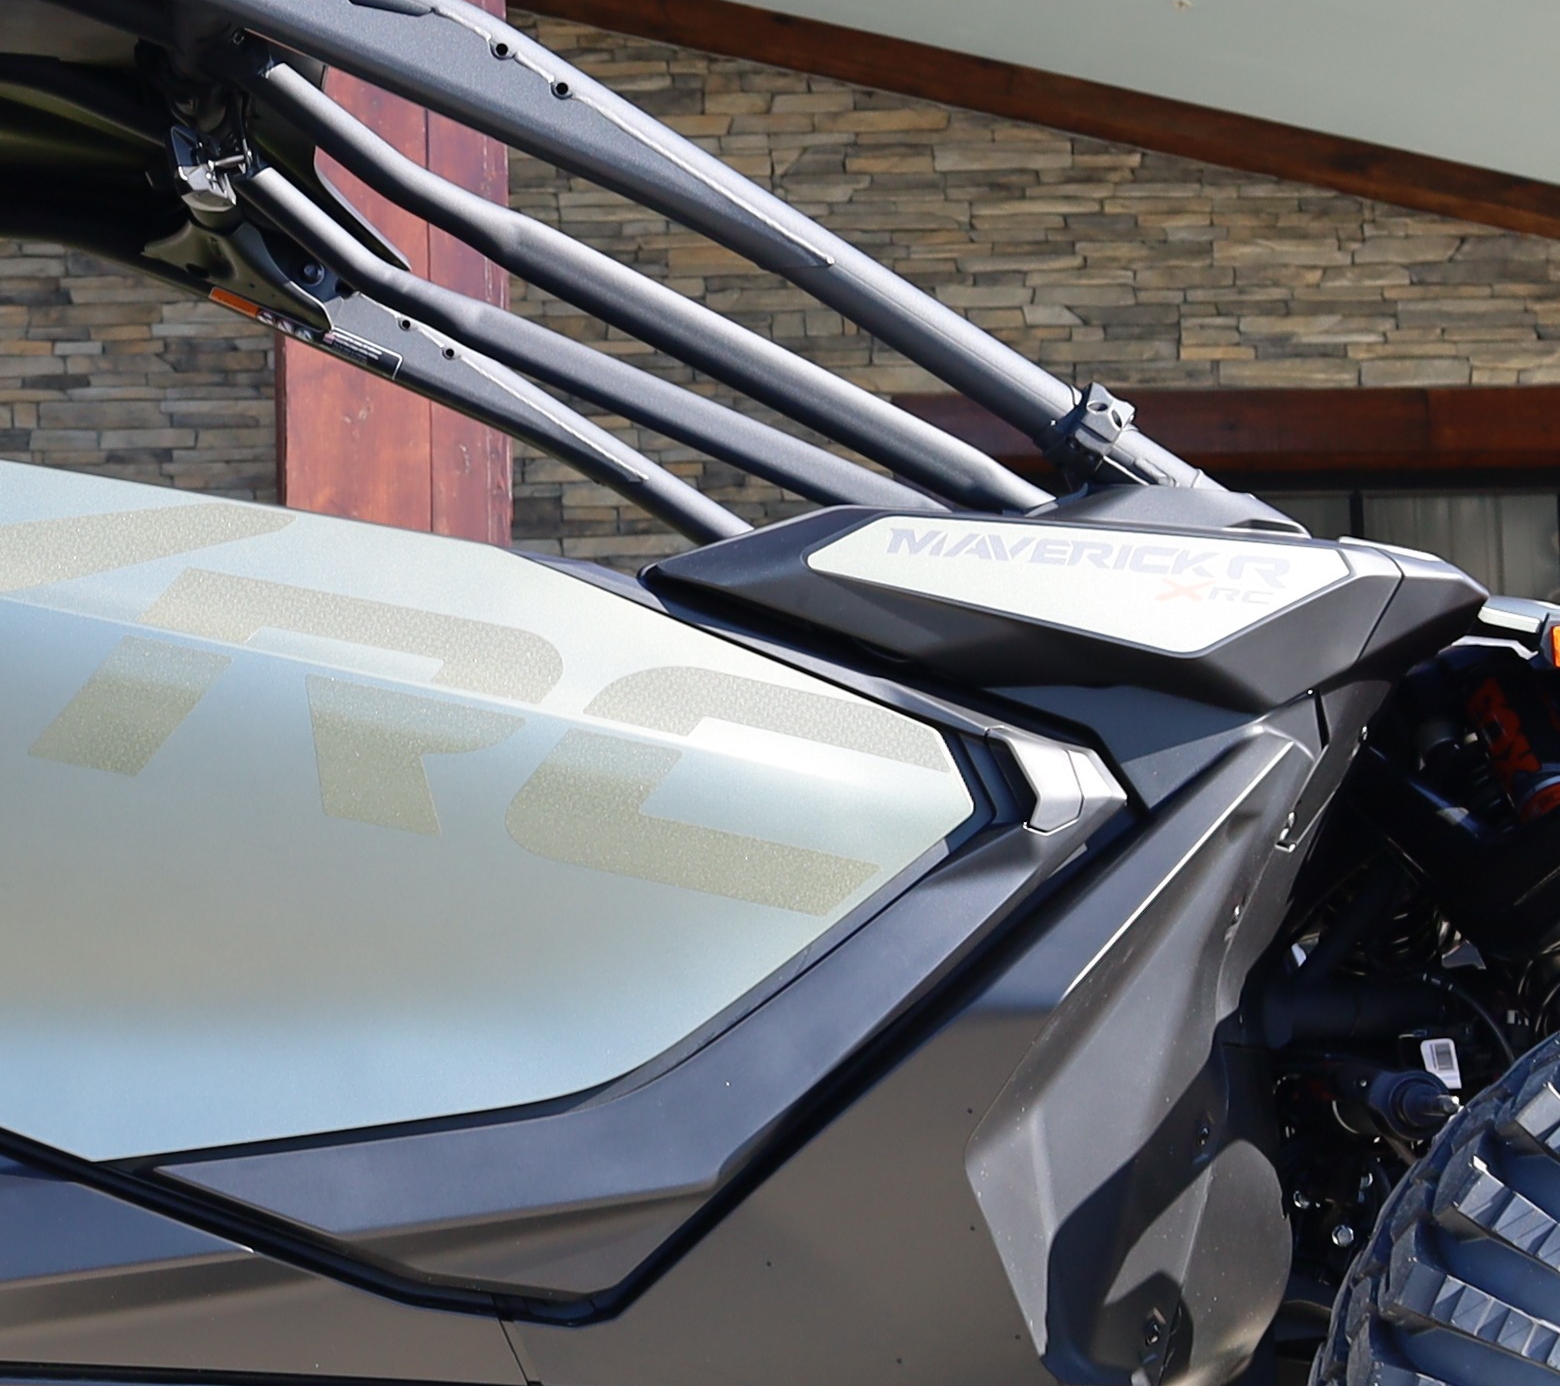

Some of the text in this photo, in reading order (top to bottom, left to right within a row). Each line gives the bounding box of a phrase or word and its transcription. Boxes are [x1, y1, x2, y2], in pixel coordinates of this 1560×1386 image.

[886, 527, 1292, 589] MAVERICK R
[1154, 577, 1277, 605] XRC
